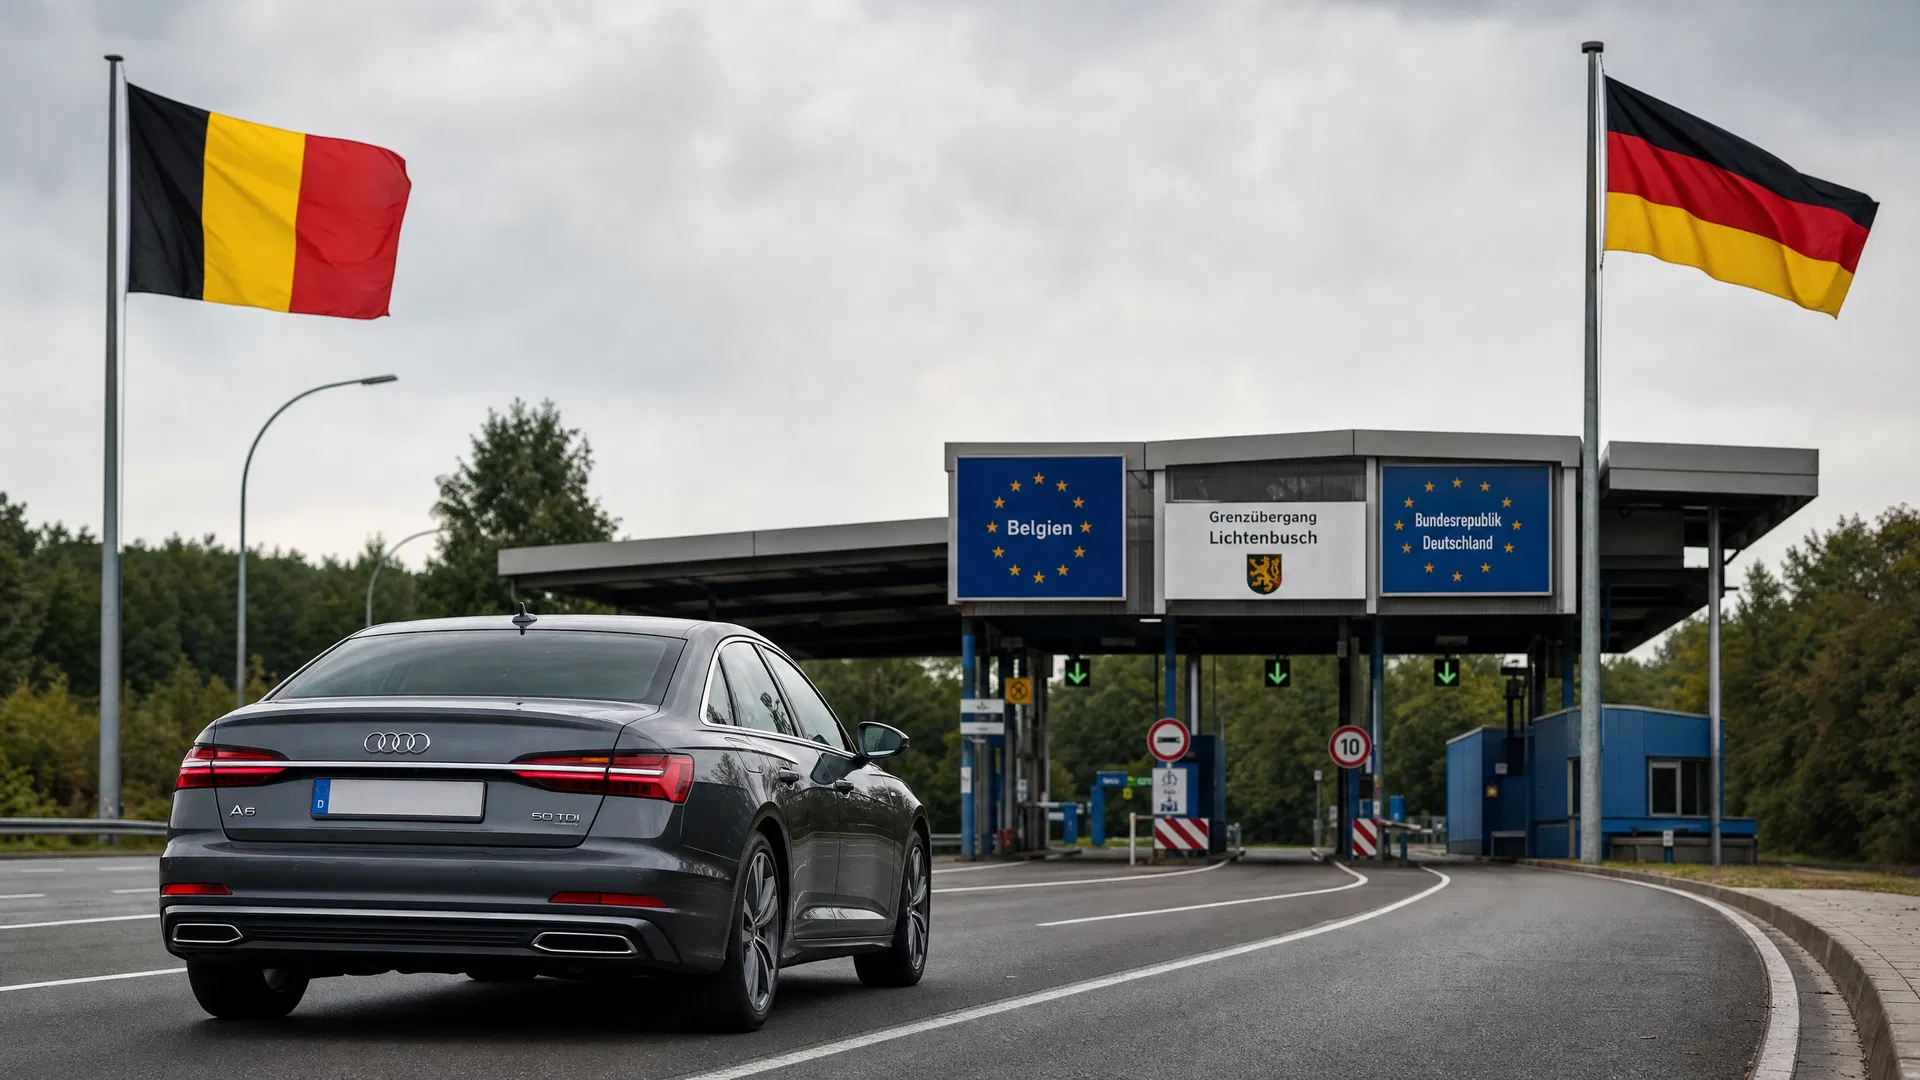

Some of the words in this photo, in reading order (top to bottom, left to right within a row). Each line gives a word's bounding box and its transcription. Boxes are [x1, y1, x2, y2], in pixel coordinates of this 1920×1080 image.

[1209, 510, 1317, 526] Grenzübergang
[1415, 512, 1502, 530] Bundesrepublik
[1007, 519, 1073, 539] Belgien
[1209, 530, 1318, 545] Lichtenbusch
[1423, 534, 1493, 551] Deutschland
[1340, 737, 1360, 756] 10
[229, 804, 256, 817] A6
[317, 799, 324, 809] D
[531, 812, 553, 821] 50
[555, 813, 580, 822] TDI
